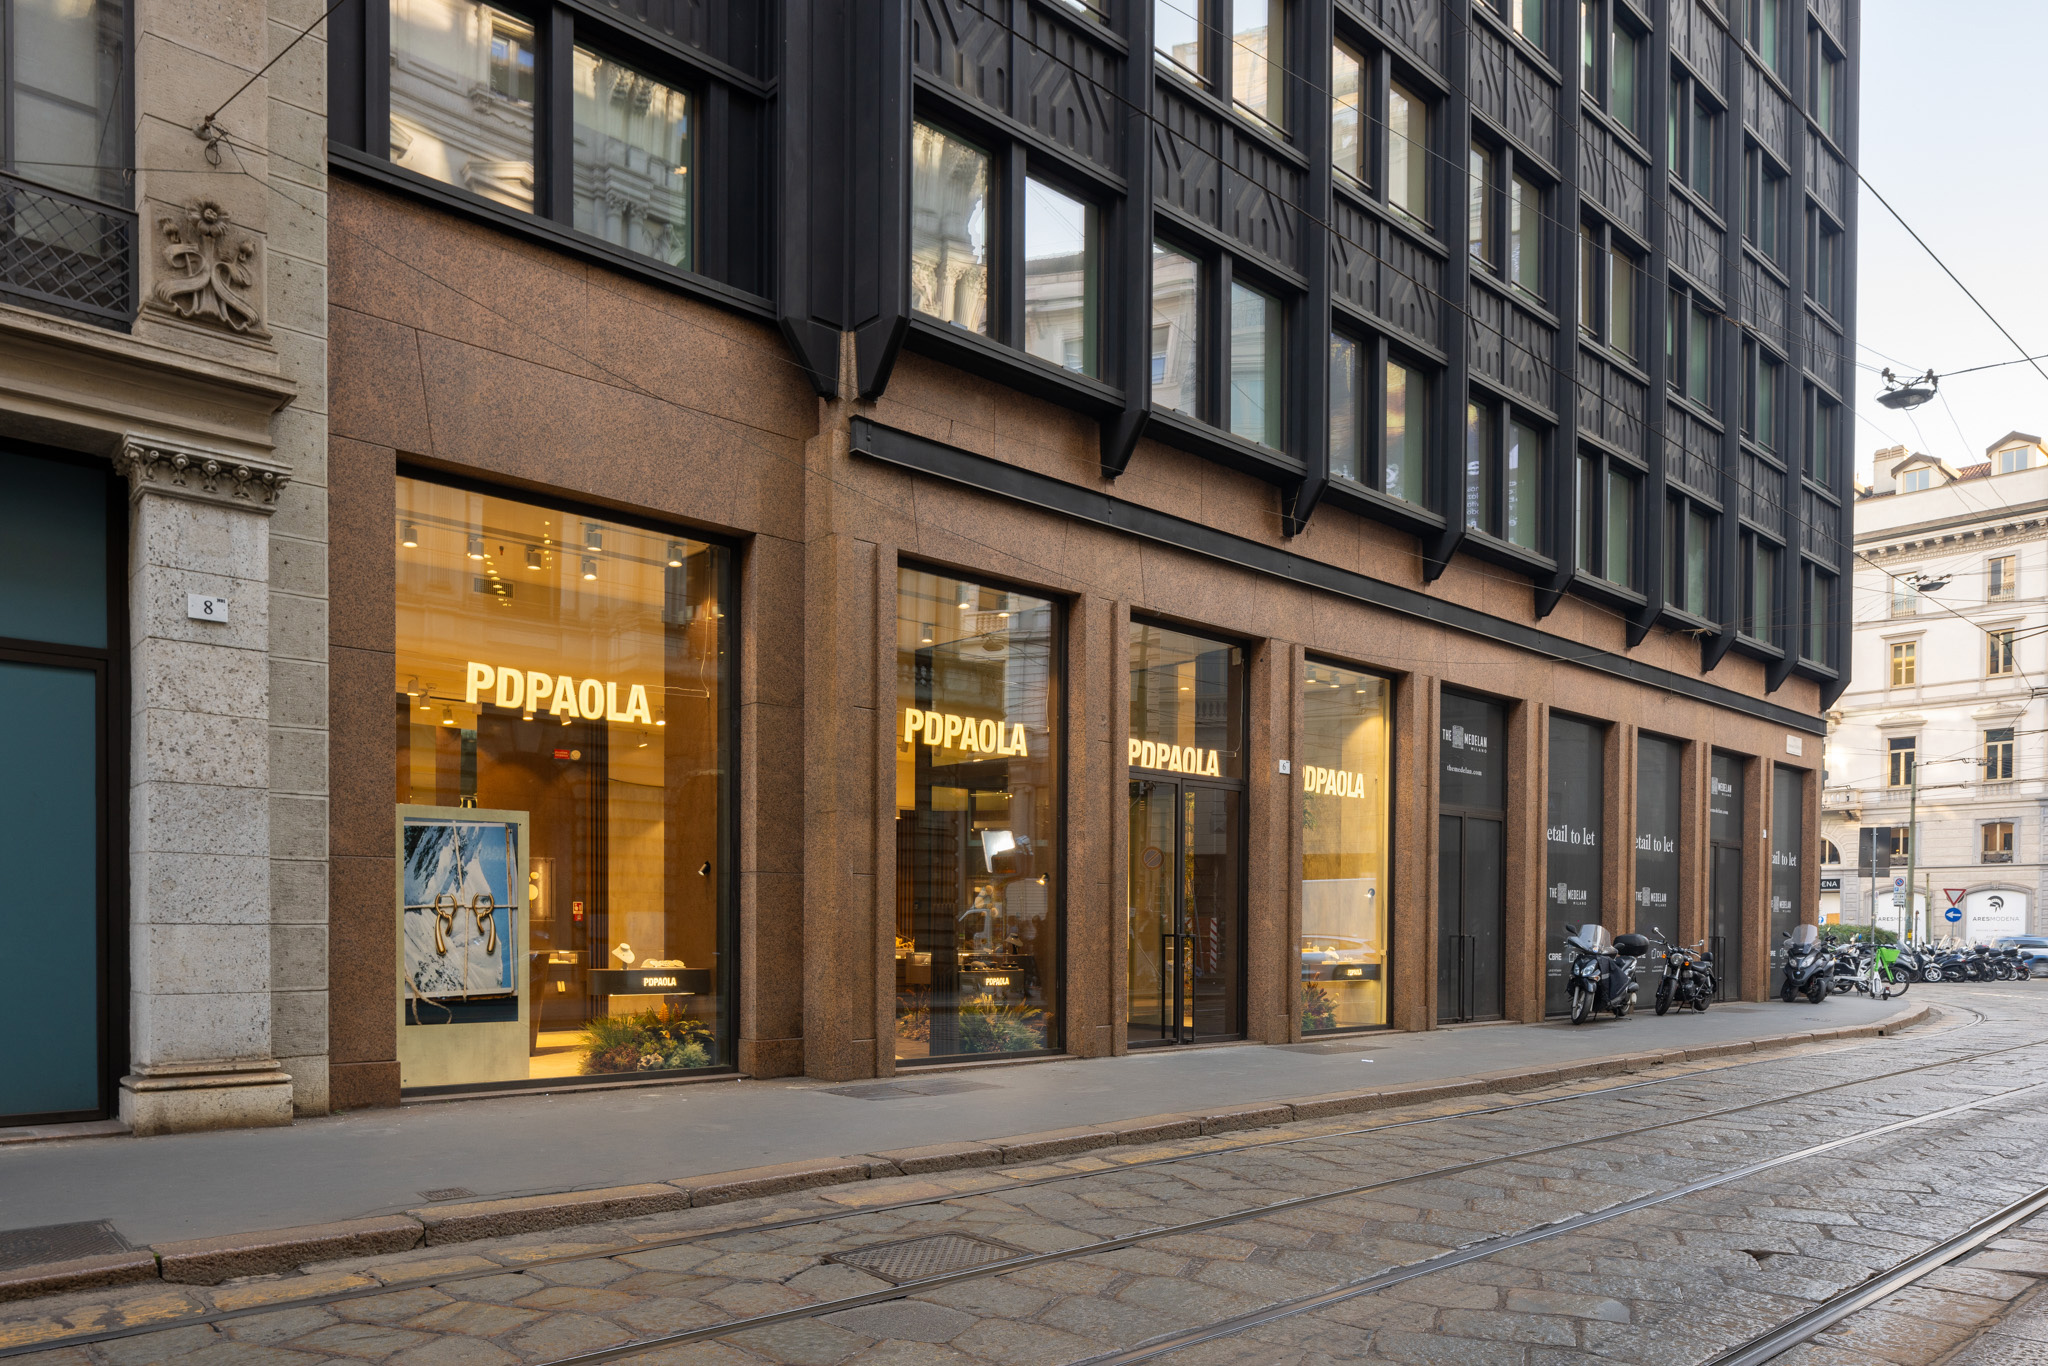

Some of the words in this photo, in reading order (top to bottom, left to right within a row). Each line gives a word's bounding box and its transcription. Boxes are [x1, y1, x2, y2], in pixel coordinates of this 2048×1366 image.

[203, 600, 214, 615] 8
[465, 661, 652, 724] PDPAOLA
[904, 707, 1028, 757] PDPAOLA
[1442, 728, 1452, 741] THE
[1464, 733, 1488, 748] MEDELAN
[1128, 738, 1220, 777] PDPAOLA
[1303, 765, 1365, 799] DPAOLA
[1547, 824, 1568, 843] etail
[1571, 829, 1581, 845] to
[1582, 827, 1596, 846] let
[1635, 833, 1651, 850] etail
[1653, 838, 1662, 852] to
[1663, 836, 1674, 853] let
[1549, 887, 1557, 898] THE
[1567, 889, 1587, 900] MEDELAN
[1820, 880, 1838, 888] ENA
[1548, 952, 1562, 960] CBRE
[643, 977, 677, 987] PDPAOLA
[985, 977, 1010, 986] PDPAOLA
